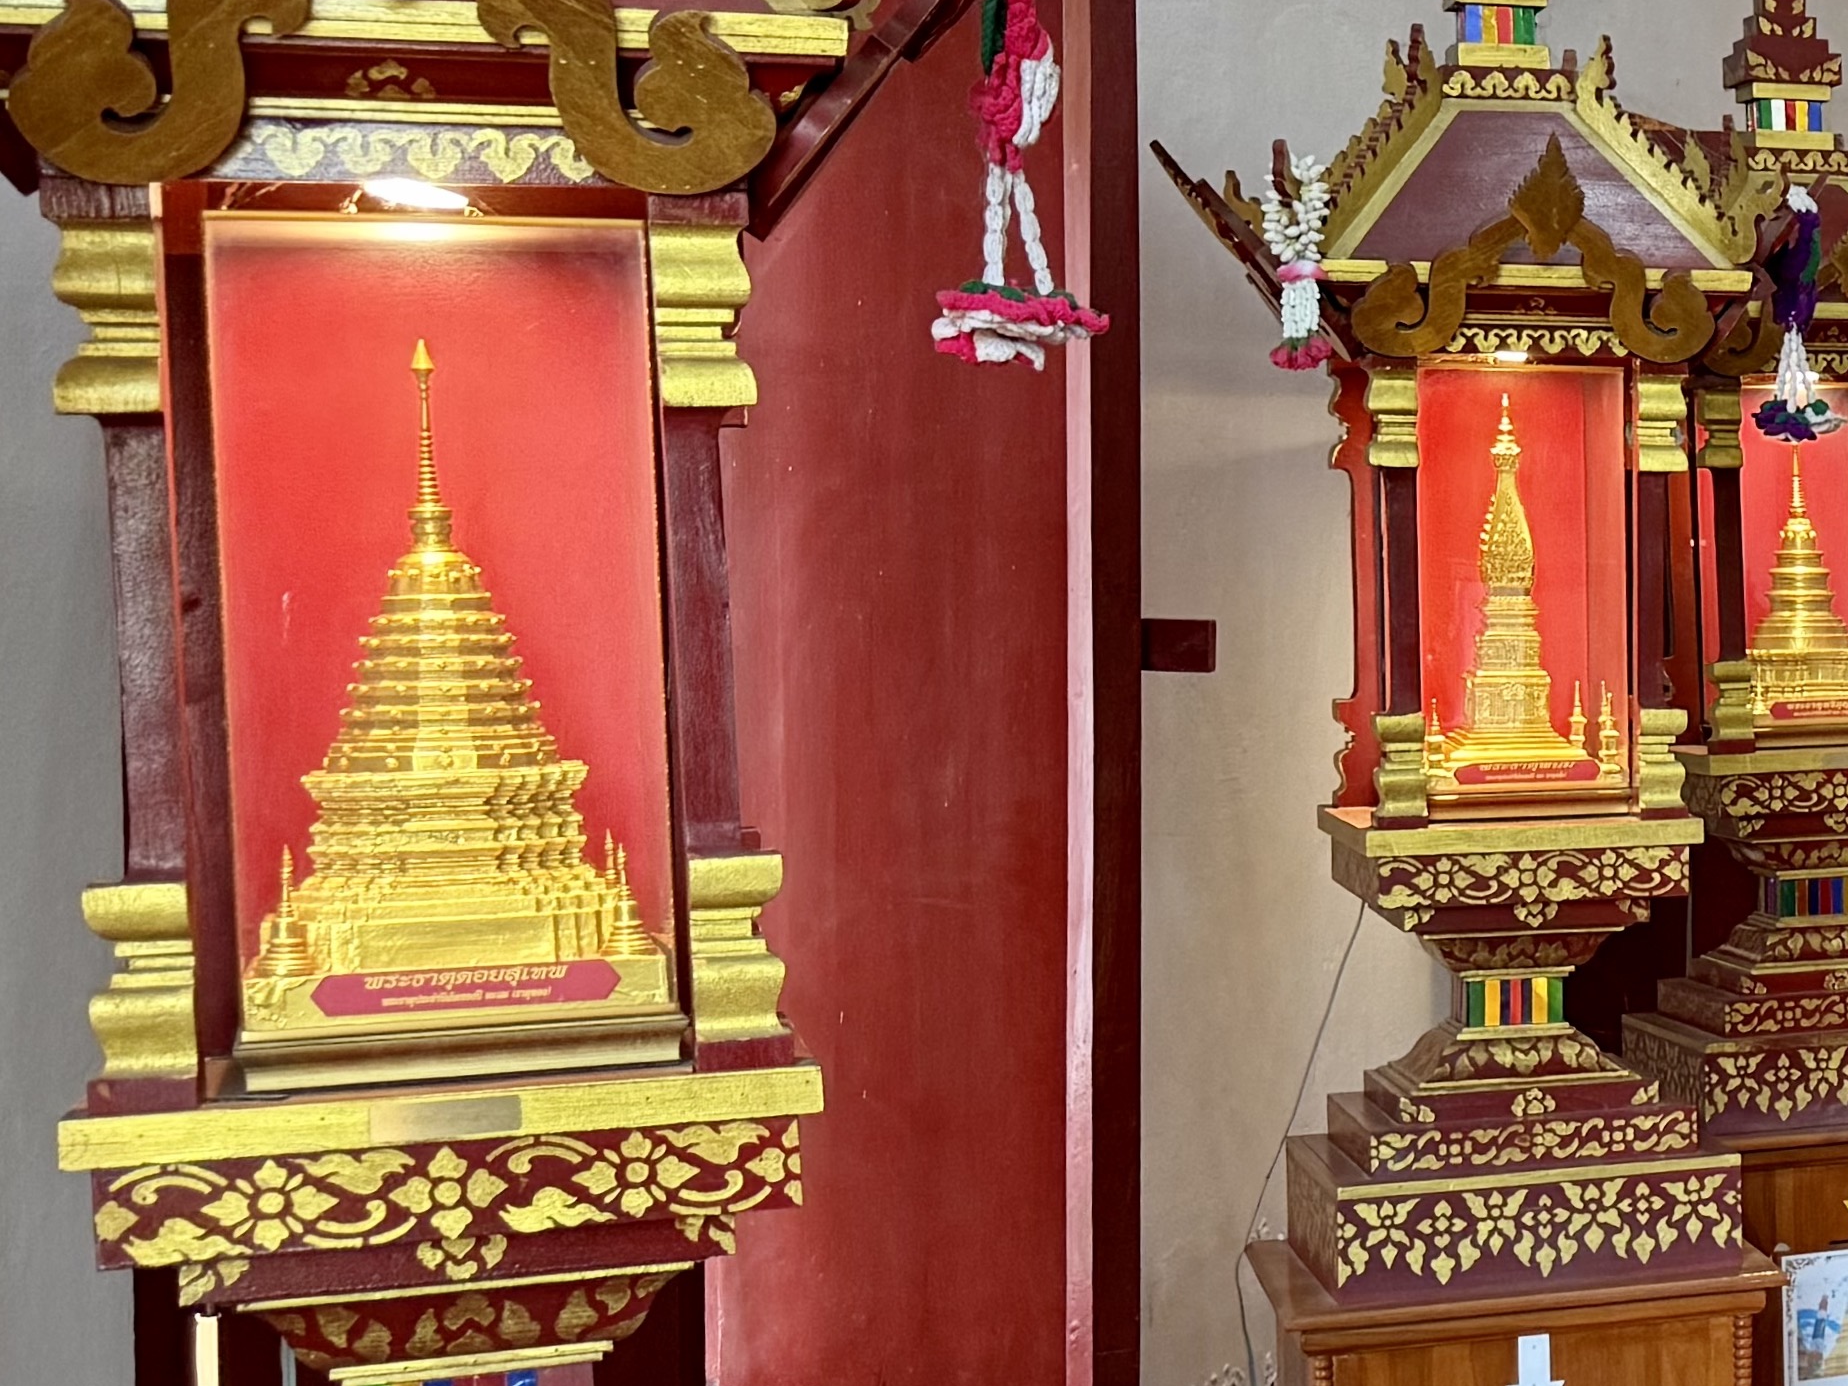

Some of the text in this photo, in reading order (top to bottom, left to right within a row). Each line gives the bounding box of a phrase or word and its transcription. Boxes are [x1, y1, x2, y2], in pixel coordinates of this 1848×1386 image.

[363, 964, 570, 991] พระธาตุดอยสุเทพ
